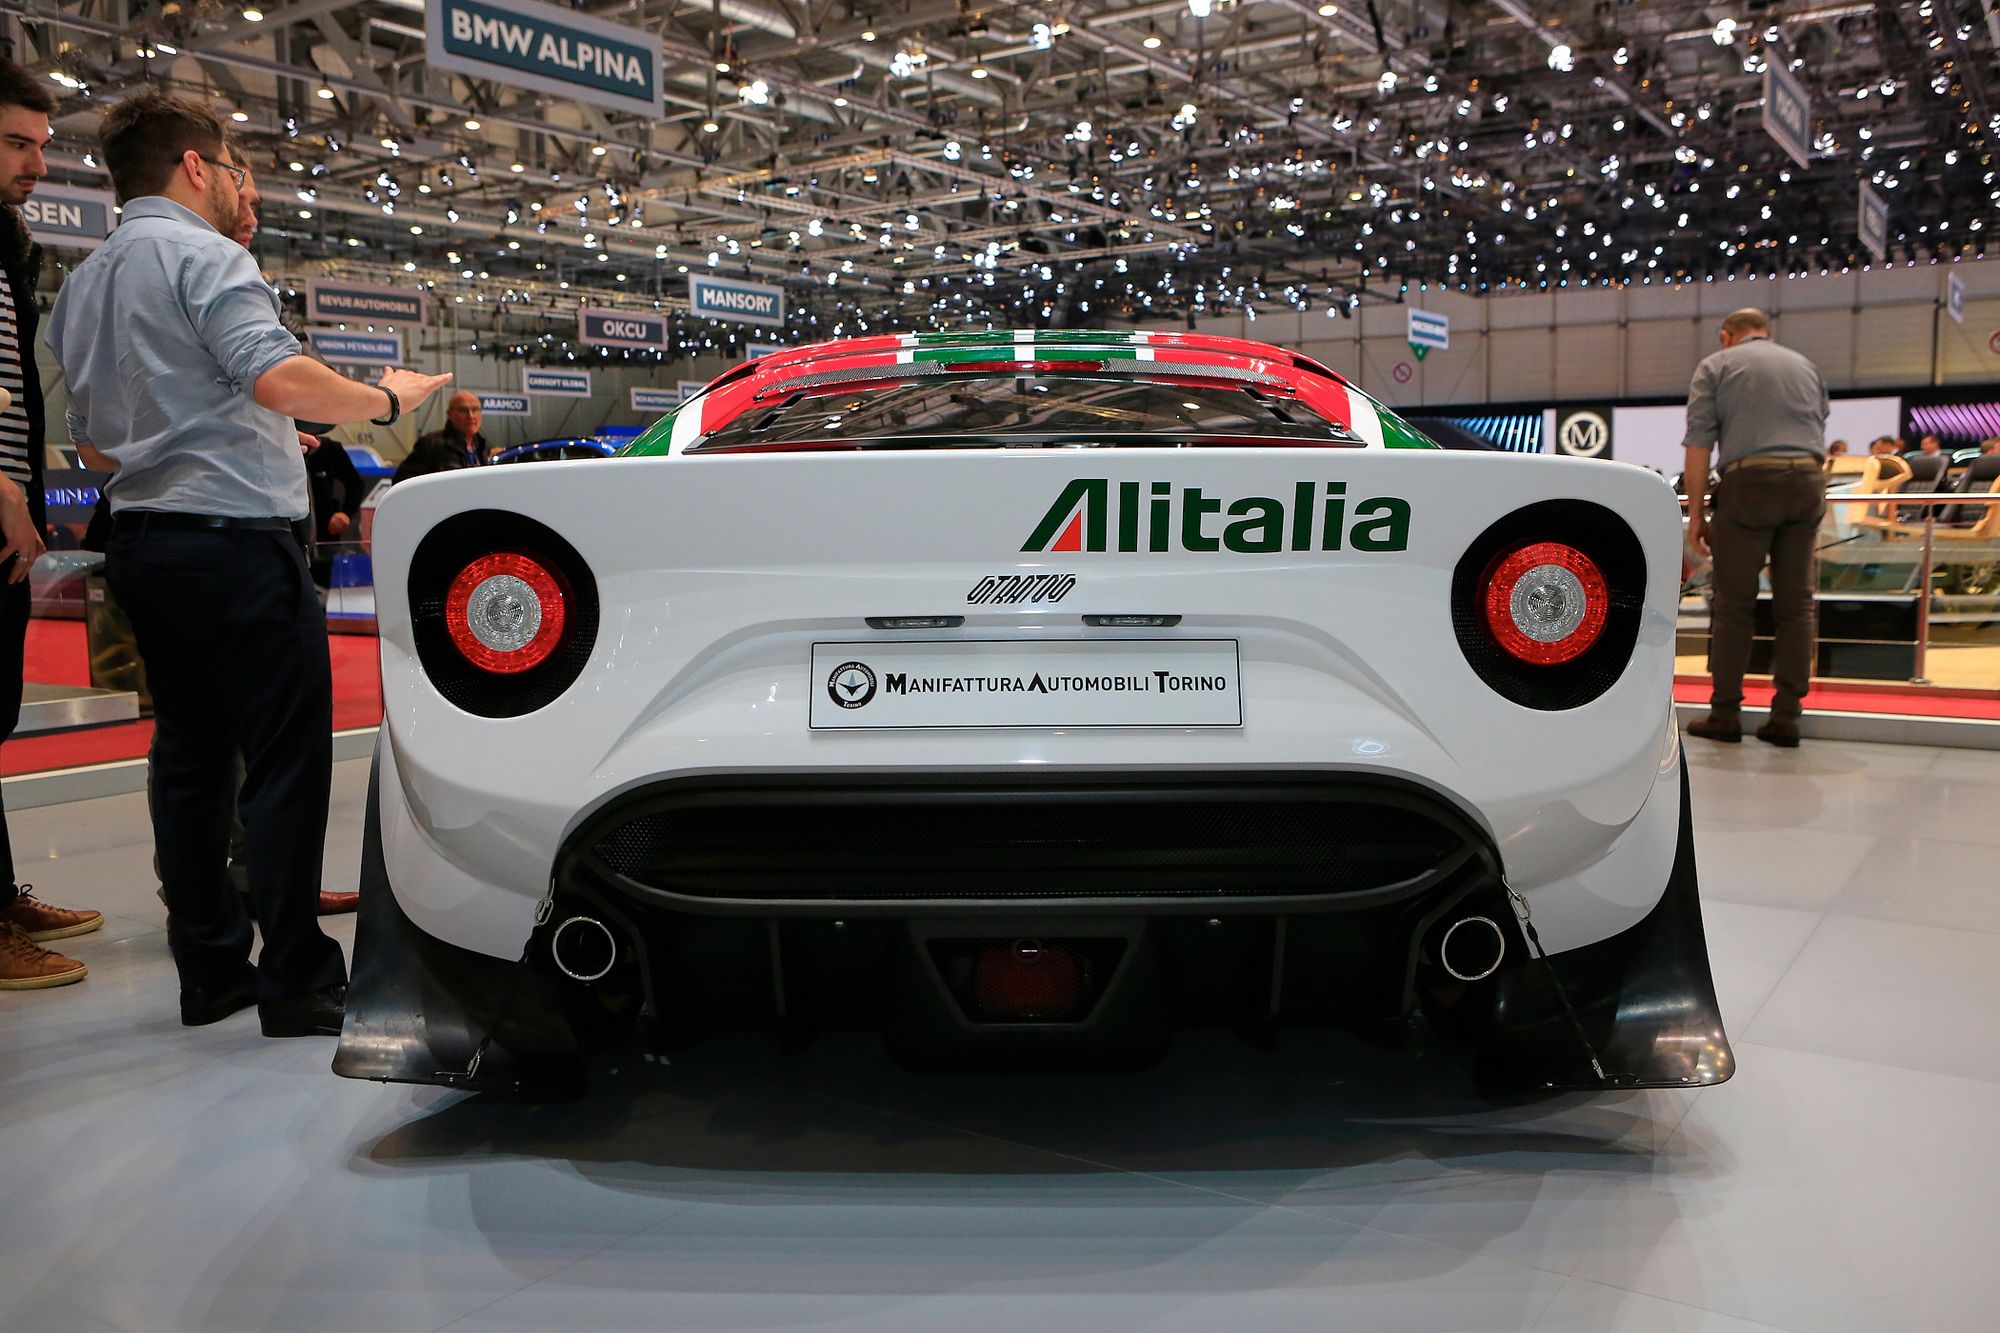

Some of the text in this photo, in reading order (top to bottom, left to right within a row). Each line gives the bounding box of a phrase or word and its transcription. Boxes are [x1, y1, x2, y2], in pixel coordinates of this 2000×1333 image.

[451, 8, 645, 86] BMW ALPINA
[319, 294, 417, 314] REVUE AUTOMOBILE
[702, 287, 773, 312] MANSORY
[602, 319, 647, 339] OKCU
[316, 339, 348, 352] UNION
[561, 378, 587, 389] GLOBAL
[483, 398, 523, 410] ARAMCO
[1019, 478, 1411, 554] Alitalia
